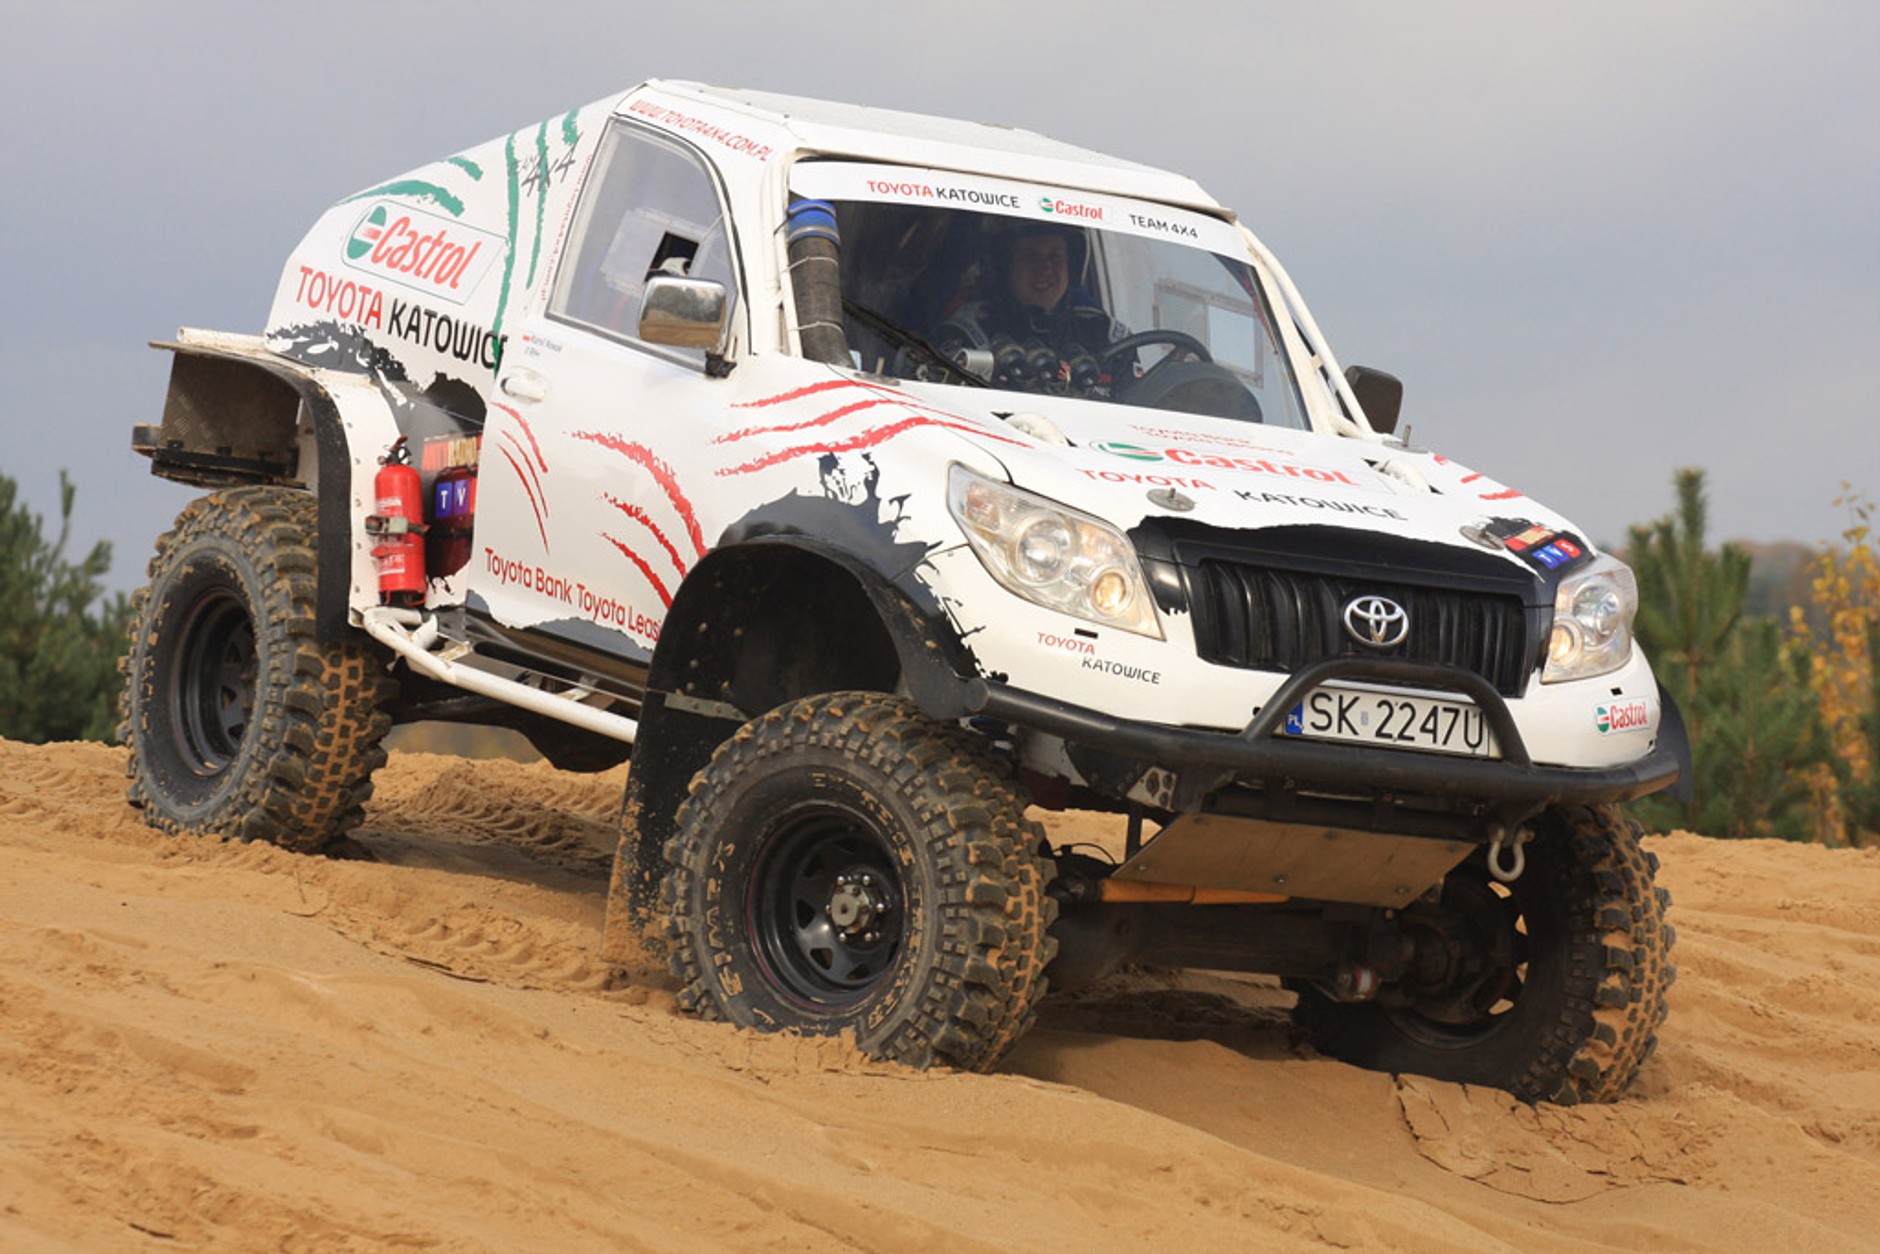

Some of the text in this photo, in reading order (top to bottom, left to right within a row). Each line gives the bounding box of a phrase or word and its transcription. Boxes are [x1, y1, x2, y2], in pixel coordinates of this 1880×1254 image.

[866, 180, 1021, 209] TOYOTA KATOWICE
[1055, 200, 1103, 220] Castrol
[1129, 213, 1168, 231] TEAM
[370, 216, 482, 289] Castrol
[296, 265, 383, 330] TOYOTA
[1164, 448, 1363, 488] Castrol
[1075, 467, 1409, 521] TOYOTA KATOWICE
[485, 547, 533, 588] Toyota
[536, 567, 573, 605] Bank
[576, 583, 625, 625] Toyota
[1037, 632, 1096, 655] TOYOTA
[1082, 656, 1162, 685] KATOWICE
[1310, 692, 1484, 749] SK 2247U
[1610, 702, 1648, 730] Castrol
